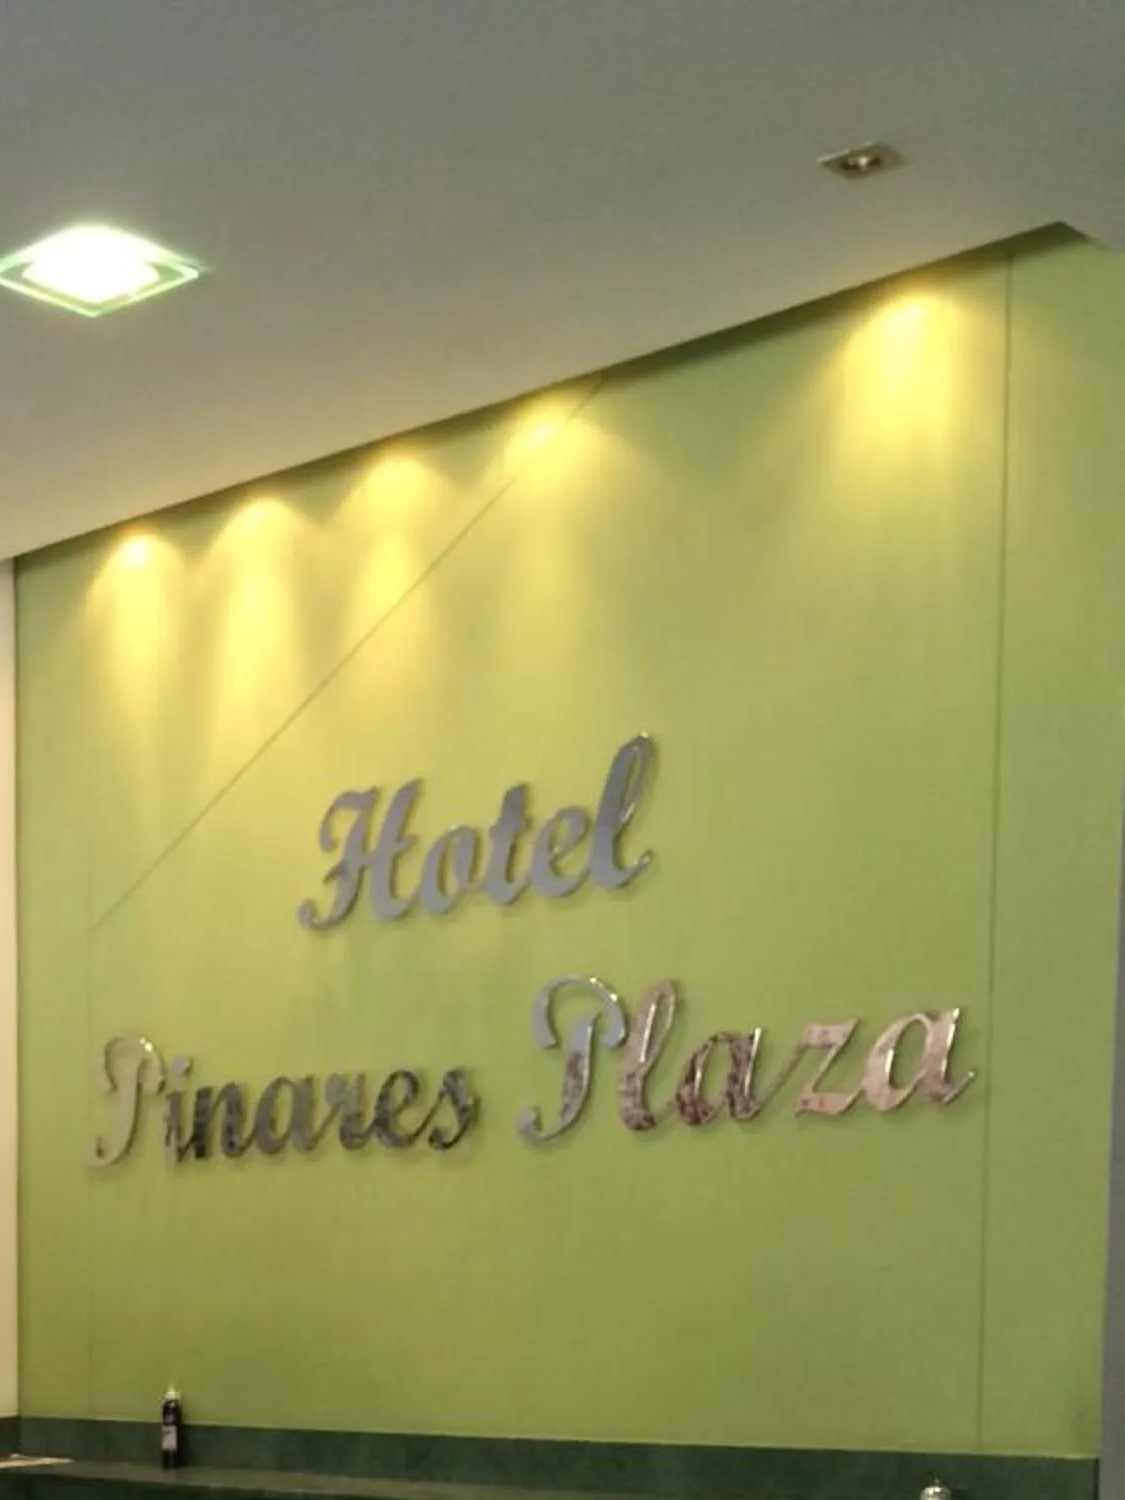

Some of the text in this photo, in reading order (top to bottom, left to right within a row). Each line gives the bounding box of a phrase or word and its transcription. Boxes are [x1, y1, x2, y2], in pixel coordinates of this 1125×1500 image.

[298, 731, 654, 931] Hotel
[93, 975, 975, 1167] Pinares Plaza
